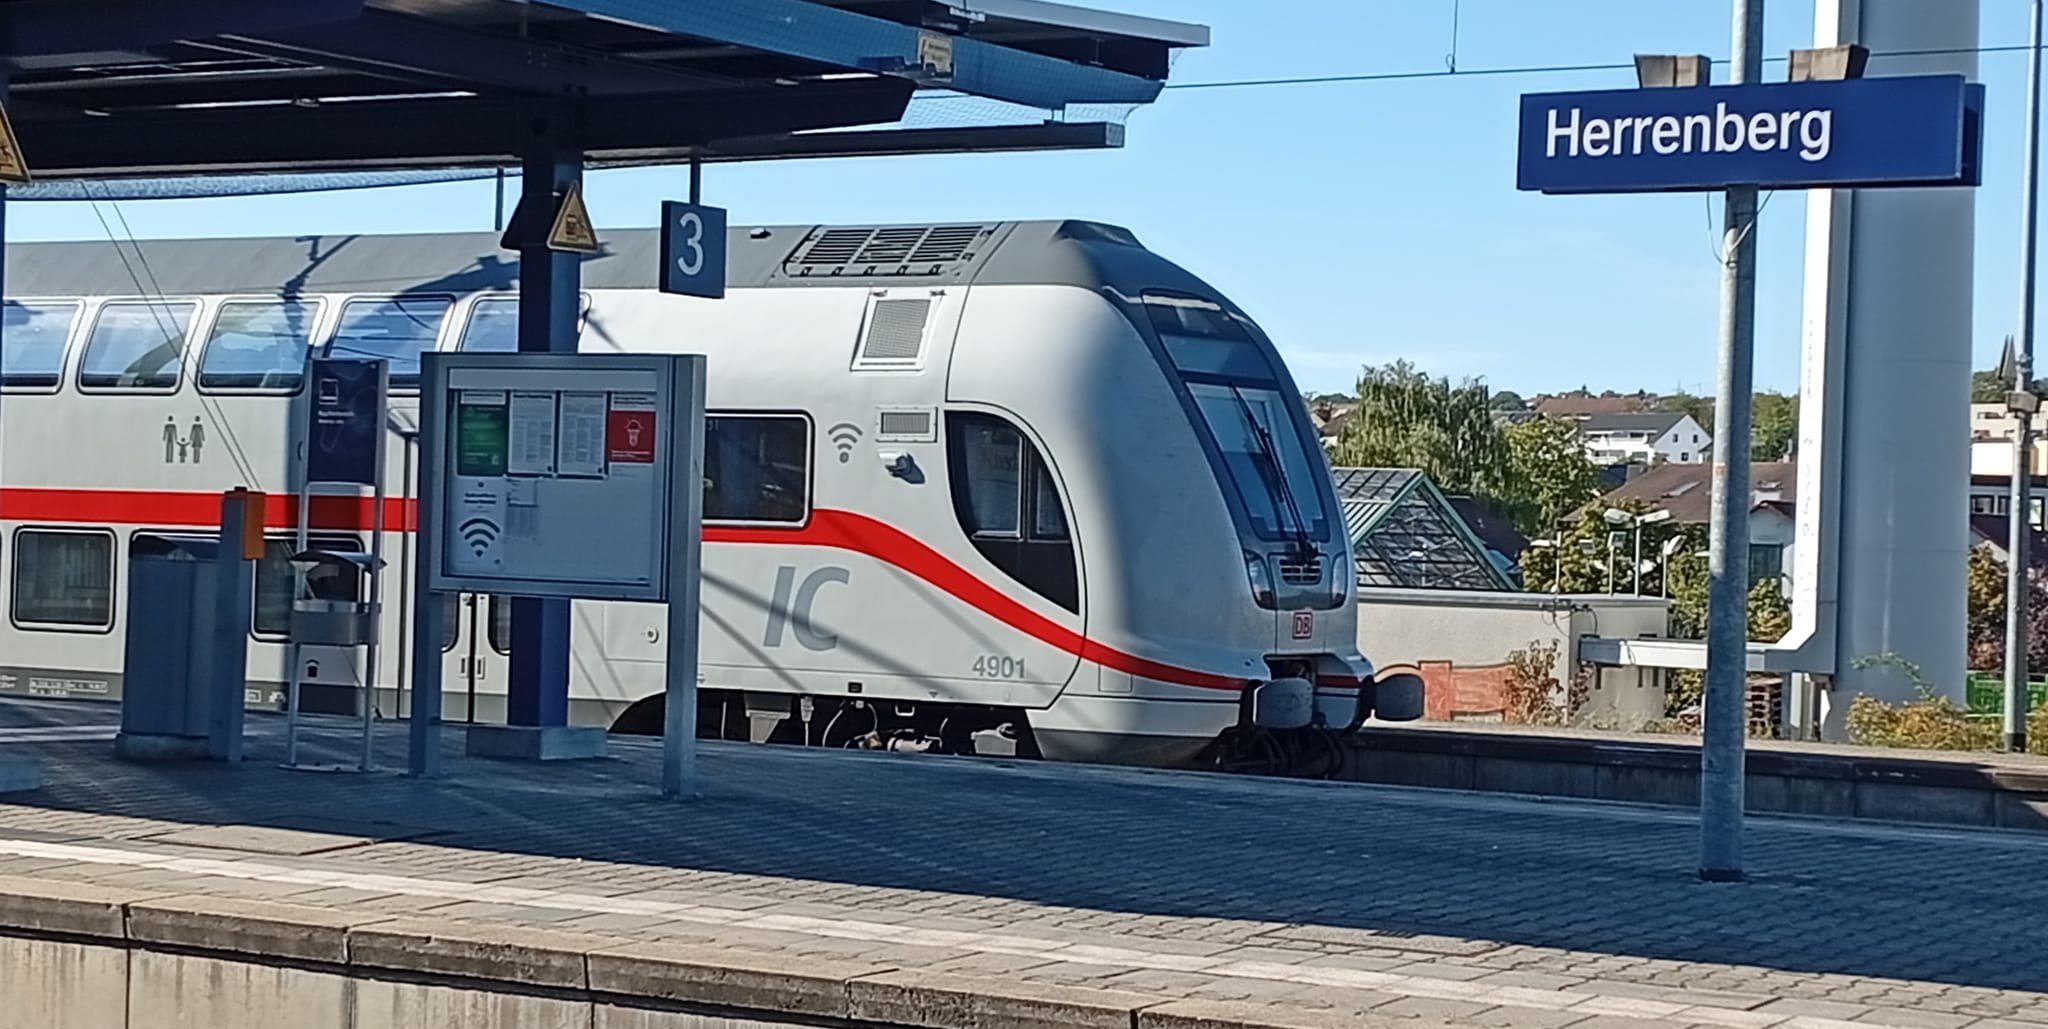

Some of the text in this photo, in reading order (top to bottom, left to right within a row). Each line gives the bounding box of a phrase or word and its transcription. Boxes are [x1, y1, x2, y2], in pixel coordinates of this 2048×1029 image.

[1546, 102, 1832, 161] Herrenberg
[677, 212, 704, 276] 3
[763, 566, 850, 651] IC
[1295, 615, 1311, 635] DB
[972, 655, 1026, 679] 4901
